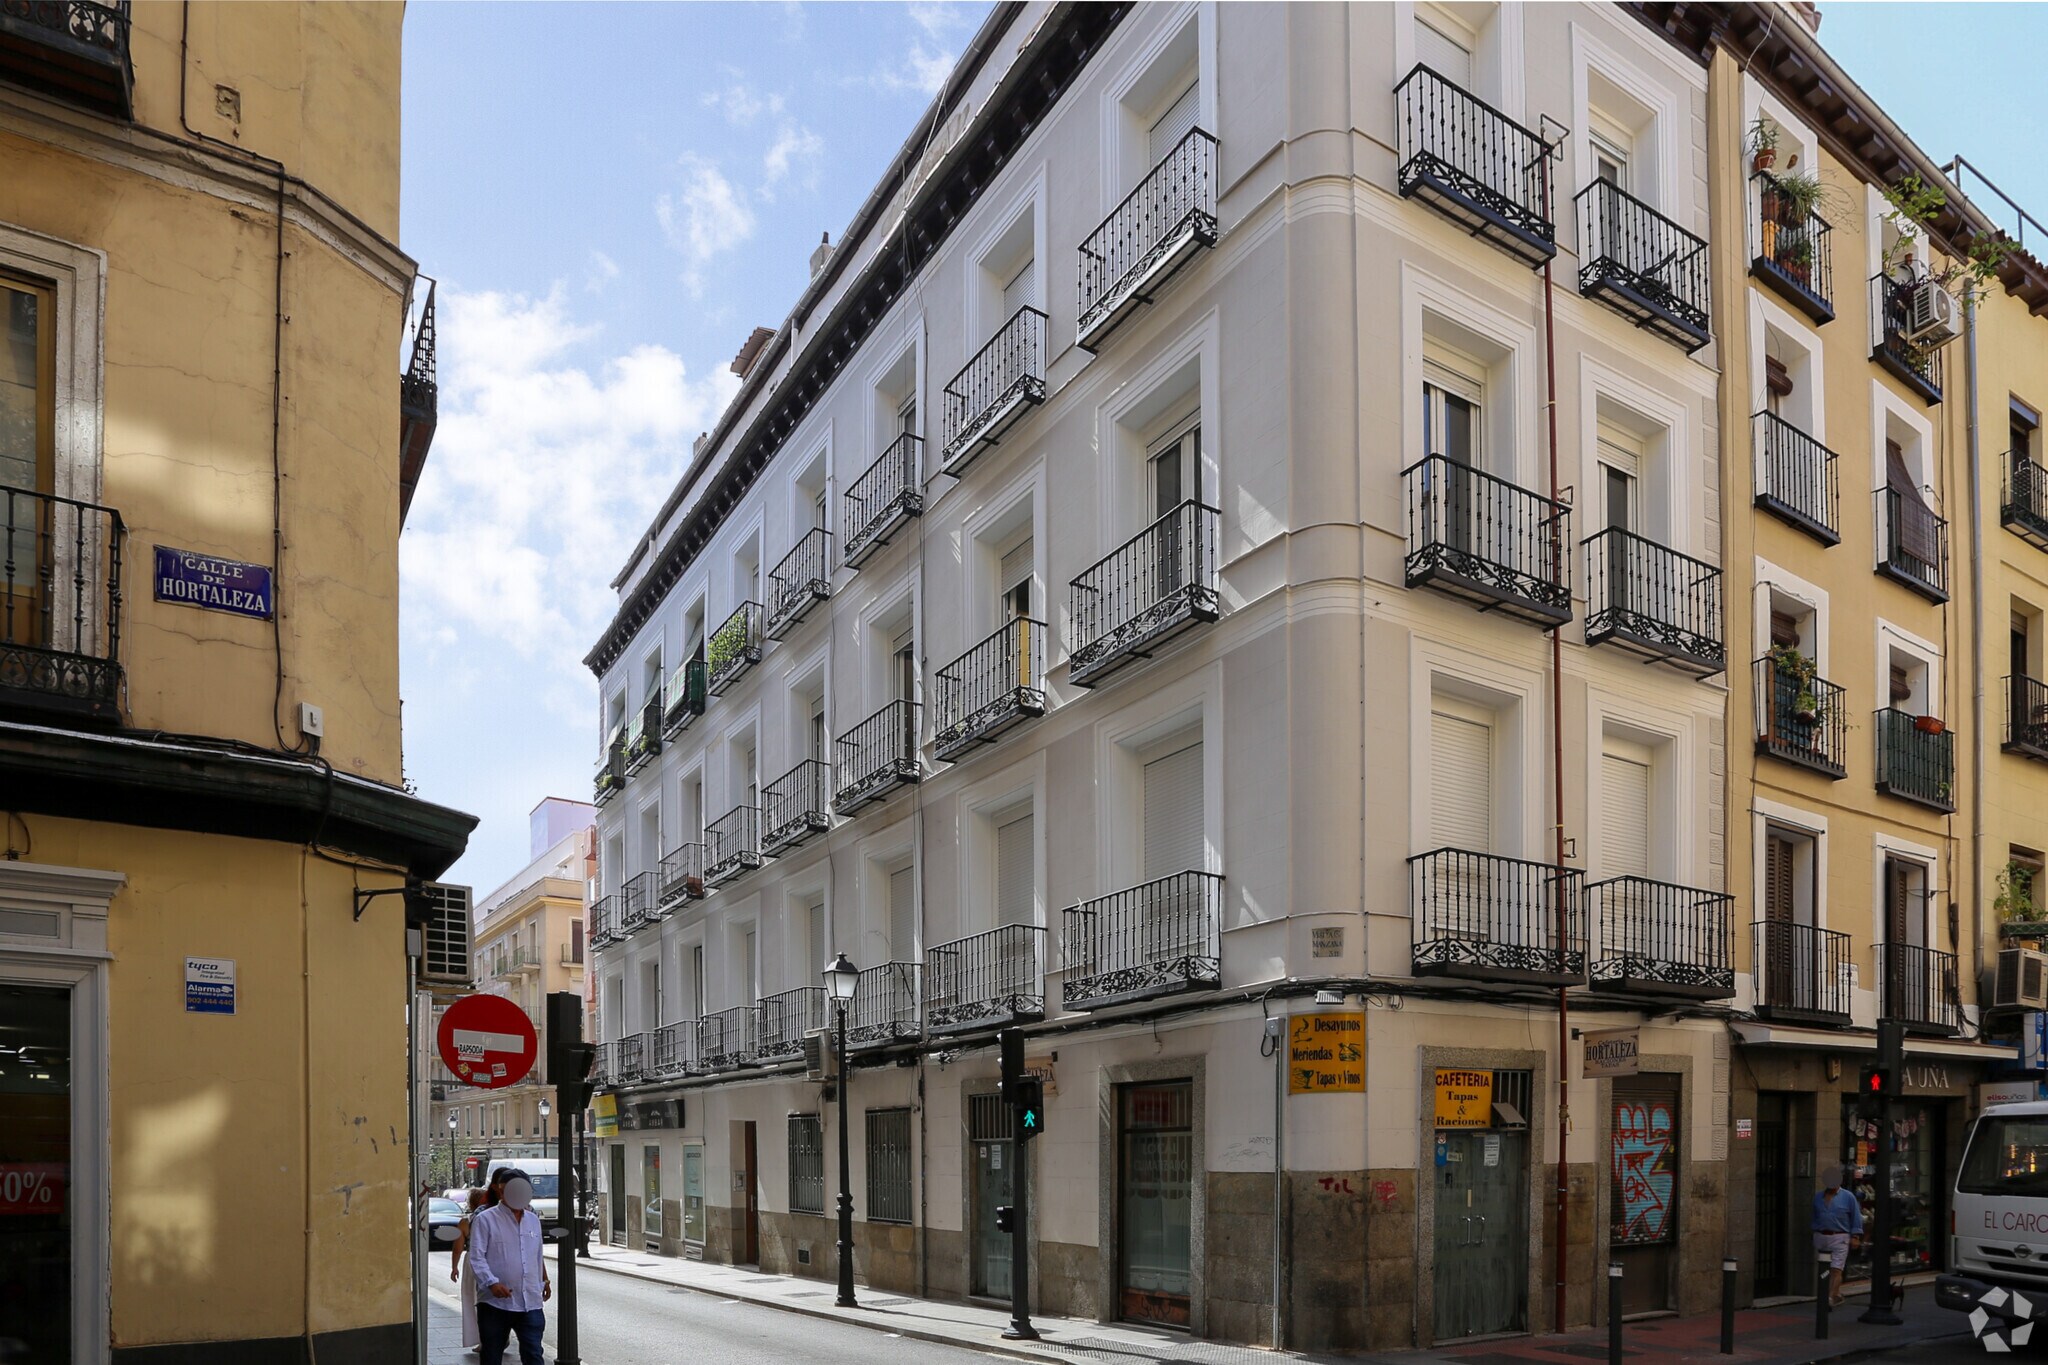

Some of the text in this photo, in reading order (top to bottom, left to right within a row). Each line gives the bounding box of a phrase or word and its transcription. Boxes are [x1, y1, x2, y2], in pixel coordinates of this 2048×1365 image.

[185, 558, 243, 579] CALLE
[202, 574, 225, 585] DE
[162, 577, 266, 612] HORTALEZA
[188, 961, 218, 971] tyco
[187, 984, 221, 993] Alarma
[1314, 1018, 1360, 1034] Desayunos
[459, 1043, 483, 1054] RAPSODA
[1292, 1046, 1333, 1062] Meriendas
[1586, 1042, 1637, 1061] HORTALEZA
[1316, 1070, 1360, 1087] Tapas y Vinos
[1435, 1072, 1490, 1087] CAFETERIA
[1917, 1065, 1949, 1088] UÑA
[1446, 1091, 1478, 1103] Tapas
[1457, 1105, 1466, 1115] &
[1436, 1116, 1486, 1126] Raciones
[1143, 1143, 1178, 1154] LOCAL
[0, 1171, 52, 1203] 0%
[1984, 1210, 1999, 1229] EL
